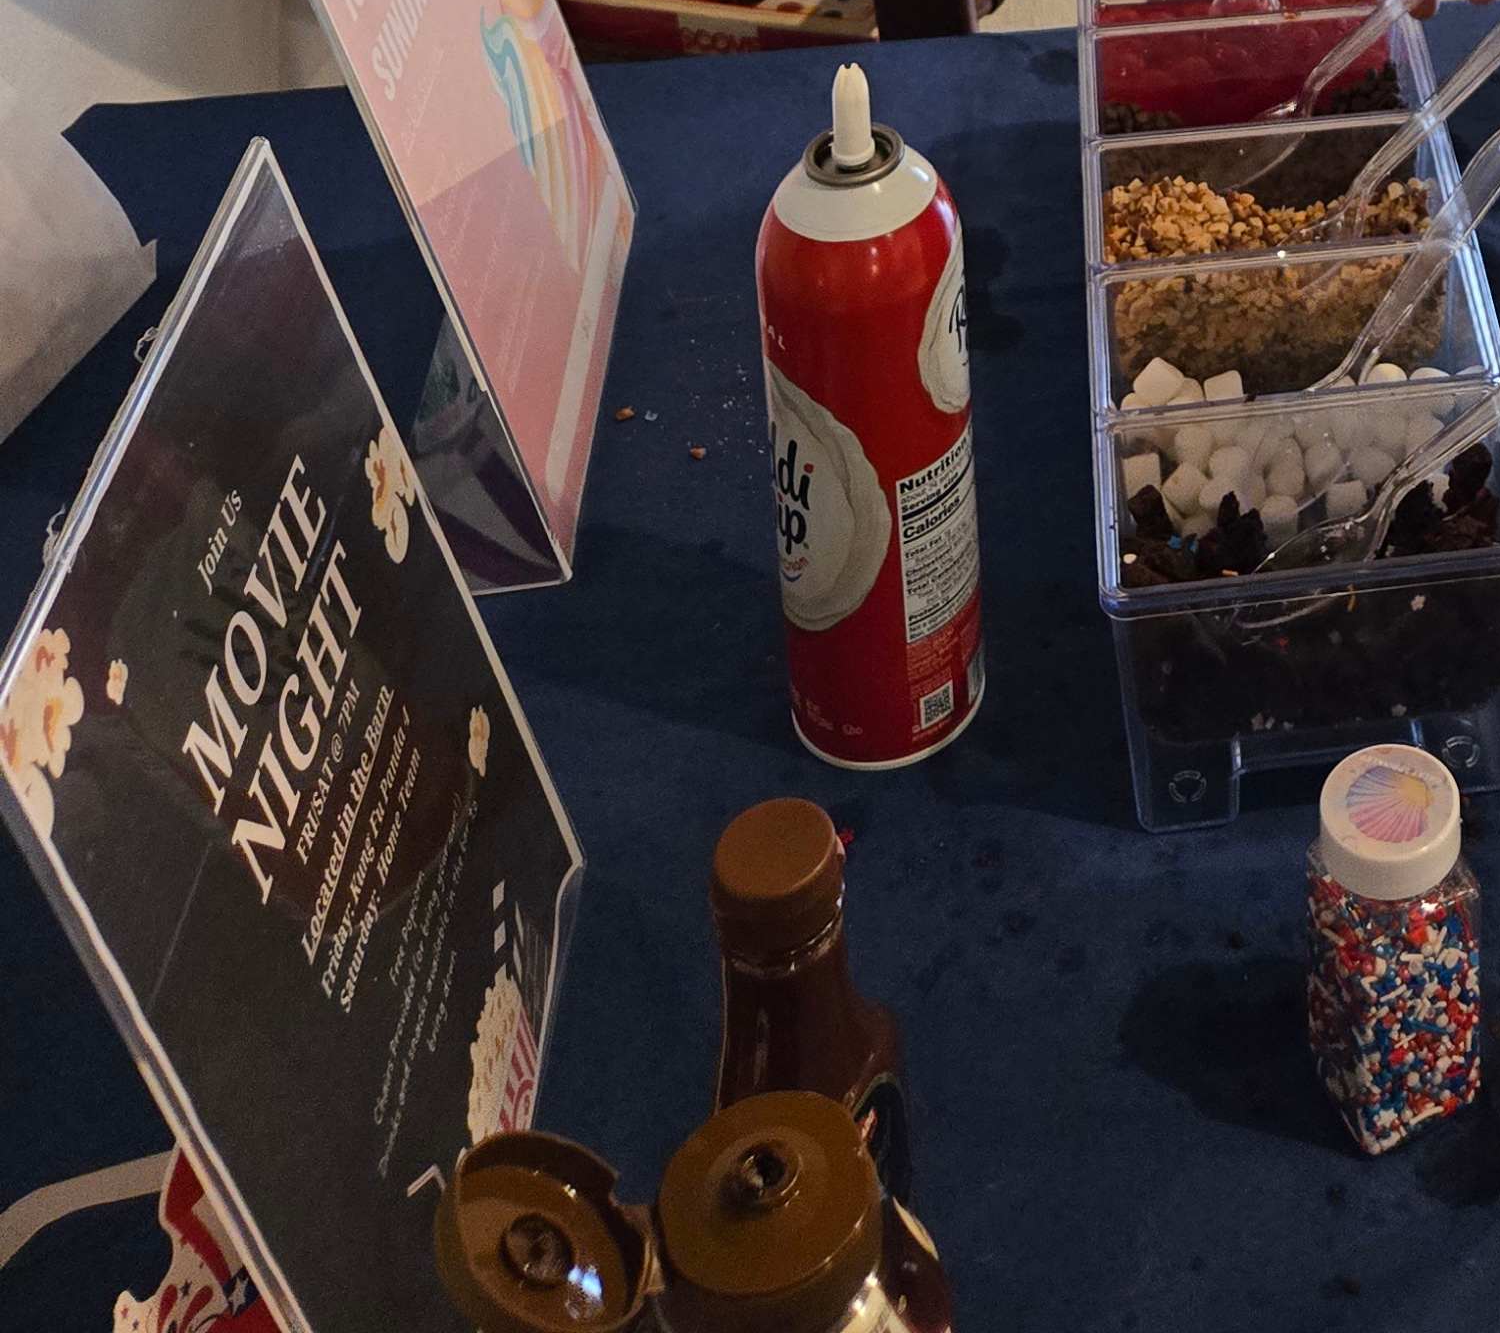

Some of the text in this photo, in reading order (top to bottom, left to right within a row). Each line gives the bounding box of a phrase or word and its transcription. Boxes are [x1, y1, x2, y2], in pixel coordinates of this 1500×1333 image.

[898, 435, 969, 495] Nutrition
[902, 494, 962, 540] Calories
[197, 488, 245, 595] Join Us
[181, 454, 329, 816] MOVIE
[231, 539, 363, 906] NIGHT
[296, 679, 361, 865] FRI/SAT @ 7PM
[302, 684, 393, 966] Located in the Barn
[321, 901, 353, 999] Friday:
[349, 831, 376, 903] Kung
[369, 801, 385, 839] Fu
[379, 723, 409, 802] Panda
[340, 746, 422, 1014] Saturday: Home Team
[389, 946, 405, 986] Free
[425, 1001, 448, 1053] bring
[399, 1060, 412, 1106] and
